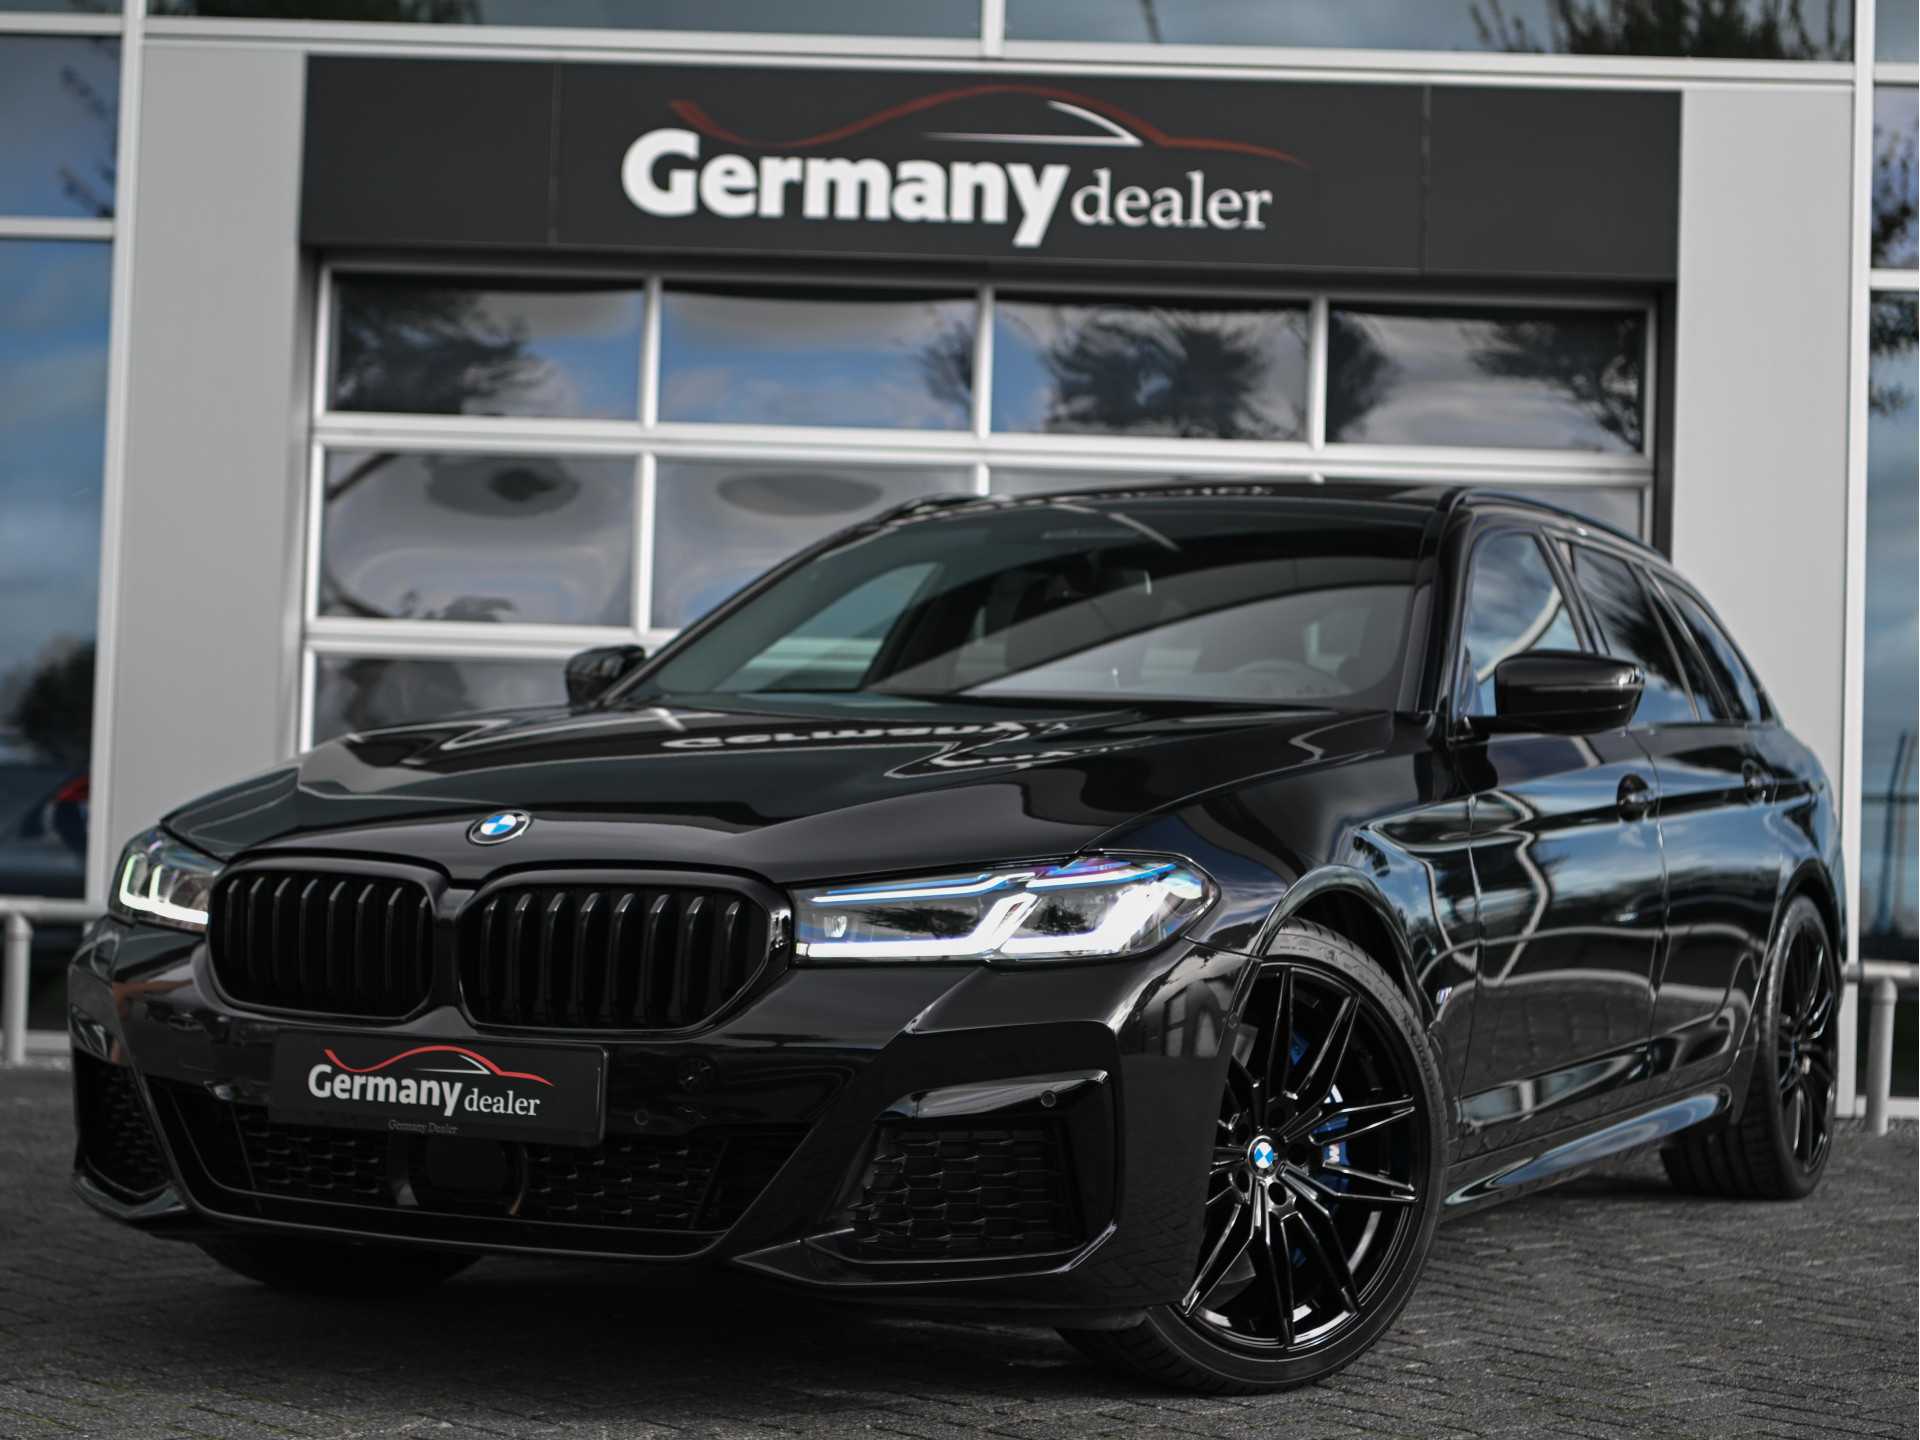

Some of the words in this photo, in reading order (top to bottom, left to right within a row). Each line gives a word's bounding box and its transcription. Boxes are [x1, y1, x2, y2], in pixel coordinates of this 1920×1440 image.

[622, 129, 1069, 247] Germany
[1070, 168, 1272, 230] dealer
[307, 1064, 463, 1116] Germany
[464, 1088, 541, 1116] dealer
[388, 1119, 427, 1133] Germany
[428, 1122, 458, 1134] Dealer
